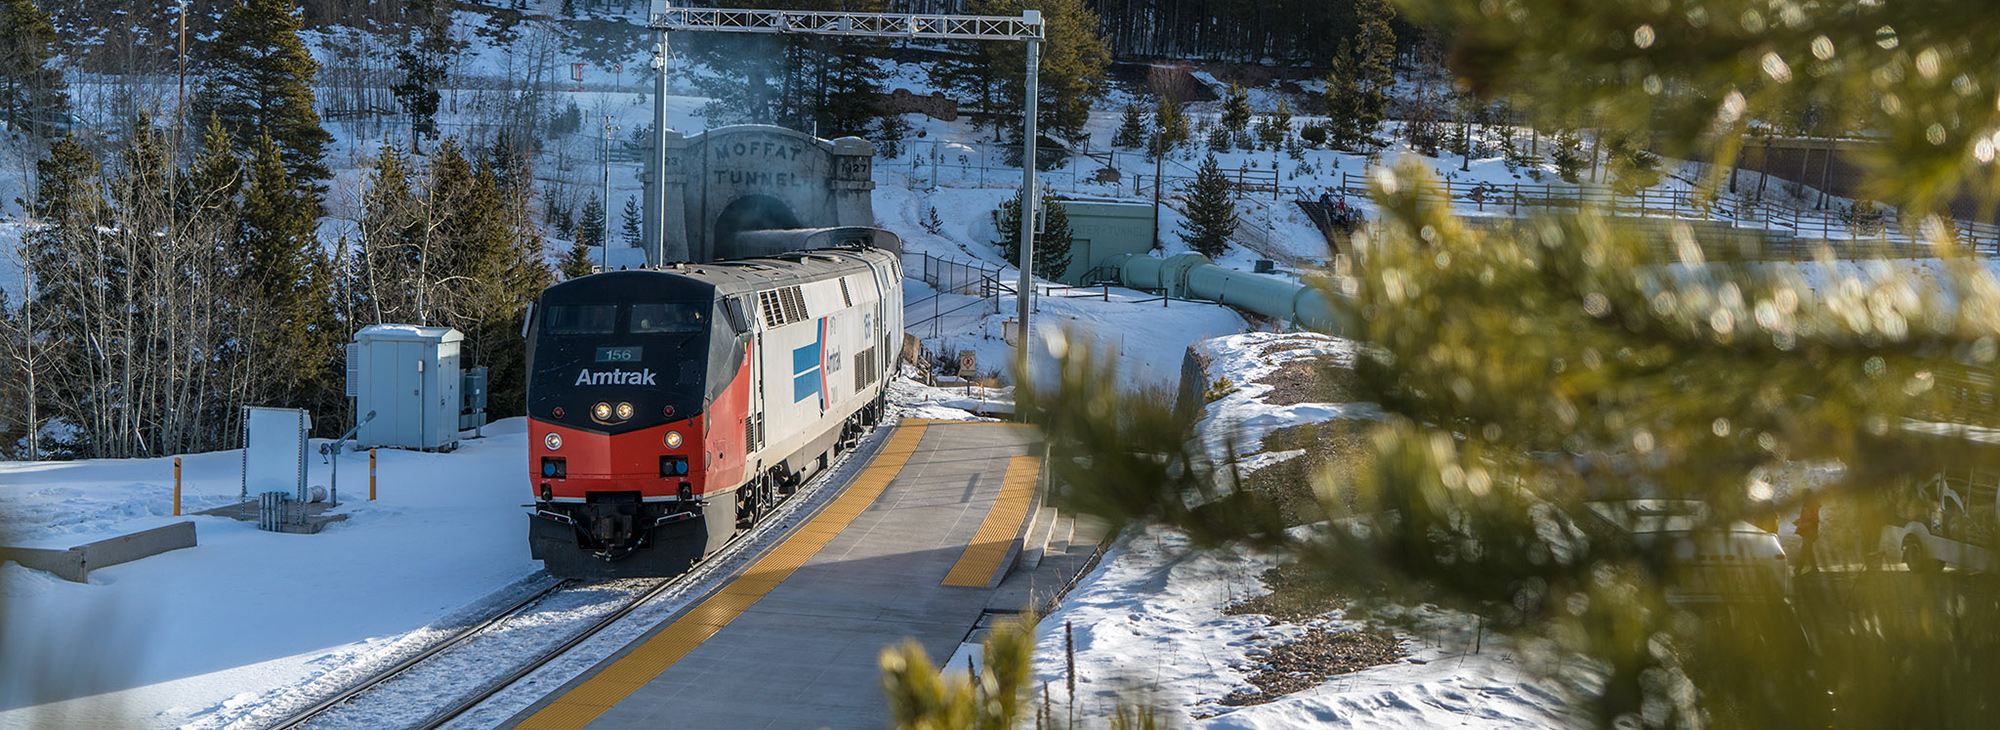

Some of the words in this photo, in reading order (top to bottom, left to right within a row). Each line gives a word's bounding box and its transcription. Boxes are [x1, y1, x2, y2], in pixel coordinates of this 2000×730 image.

[715, 141, 801, 160] MOFFAT
[714, 169, 800, 187] TUNNEL
[606, 350, 632, 361] 156
[575, 368, 656, 386] Amtrak
